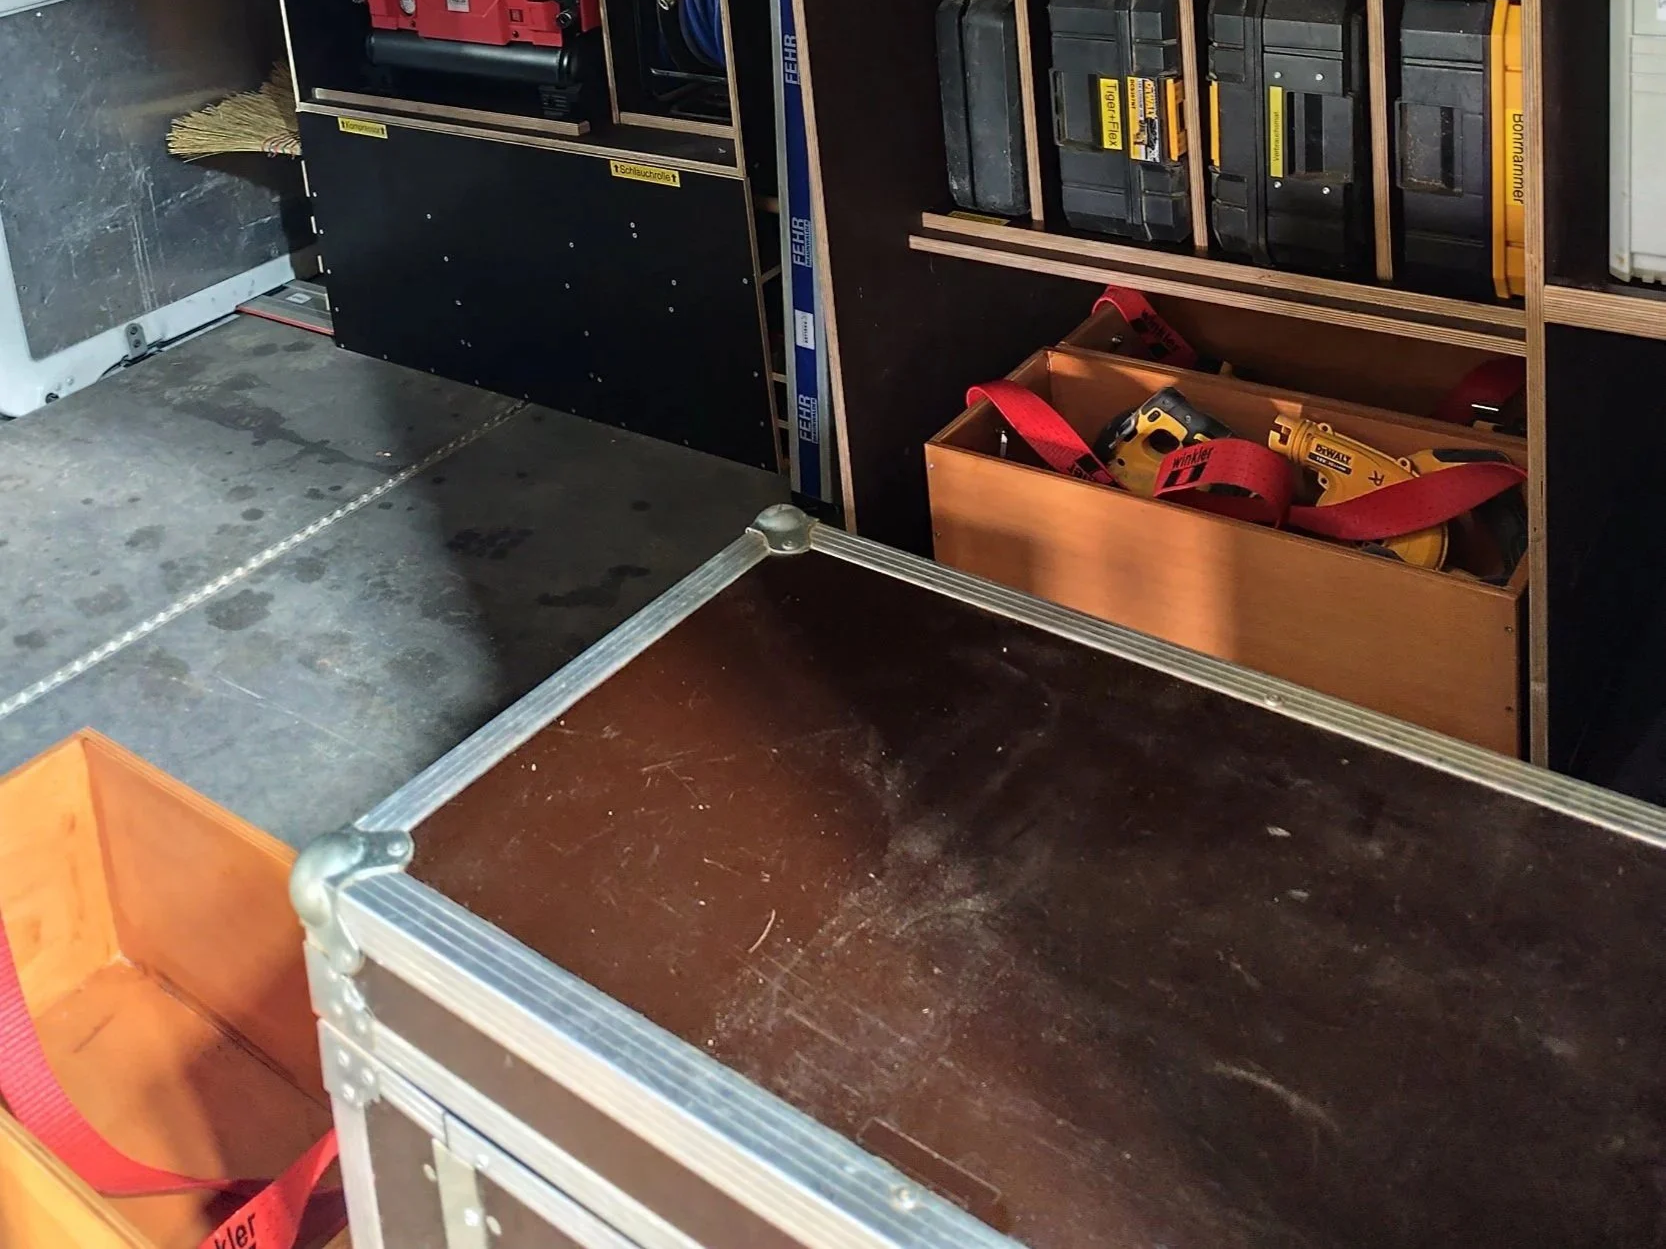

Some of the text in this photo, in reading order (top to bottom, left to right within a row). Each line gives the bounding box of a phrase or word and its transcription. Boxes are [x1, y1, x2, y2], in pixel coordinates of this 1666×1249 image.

[784, 34, 798, 85] FEHR
[1103, 84, 1120, 147] Tiger+Flex
[619, 164, 671, 181] Schlauchrolle
[791, 216, 806, 266] FEHR
[799, 394, 813, 442] FEHR
[1172, 446, 1214, 470] winkler
